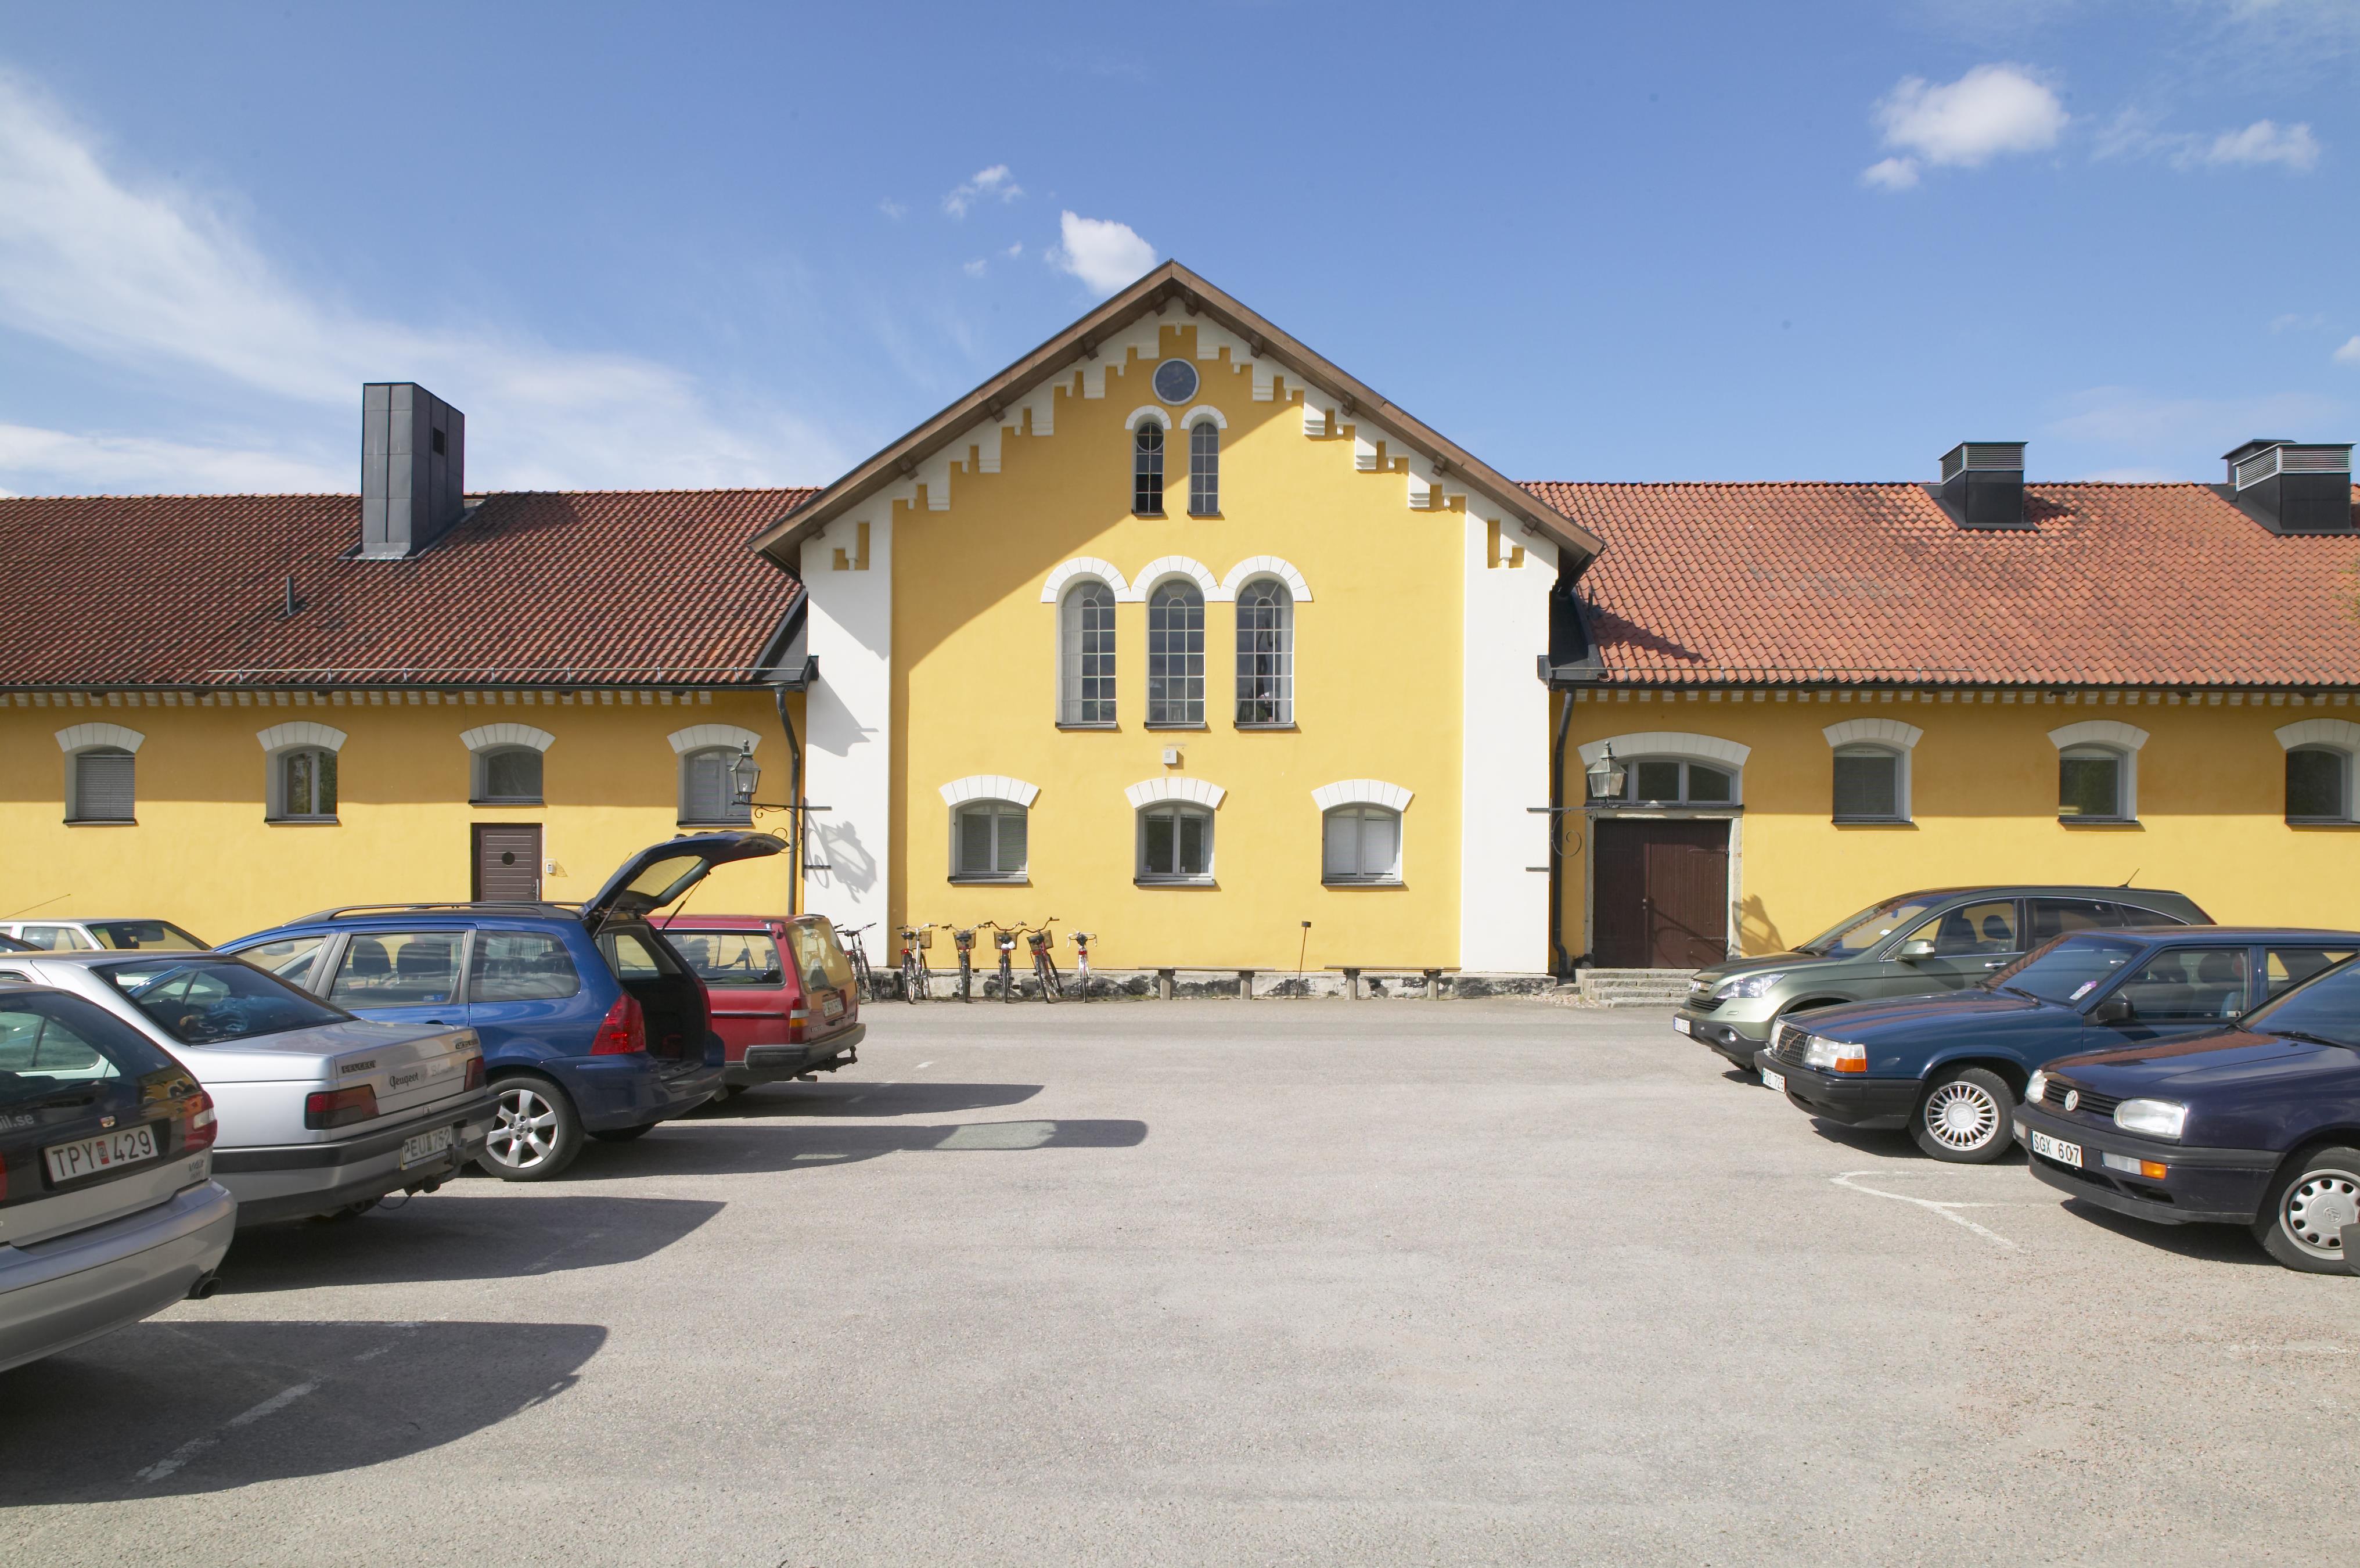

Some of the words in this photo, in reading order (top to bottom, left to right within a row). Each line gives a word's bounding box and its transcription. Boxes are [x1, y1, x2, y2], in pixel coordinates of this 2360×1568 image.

[342, 1060, 376, 1073] PEUGEOT
[1774, 1075, 1784, 1090] 725
[52, 1142, 95, 1177] TPY
[114, 1130, 152, 1161] 429
[404, 1137, 426, 1160] PEU
[2034, 1134, 2052, 1155] SGX
[2058, 1142, 2079, 1163] 607
